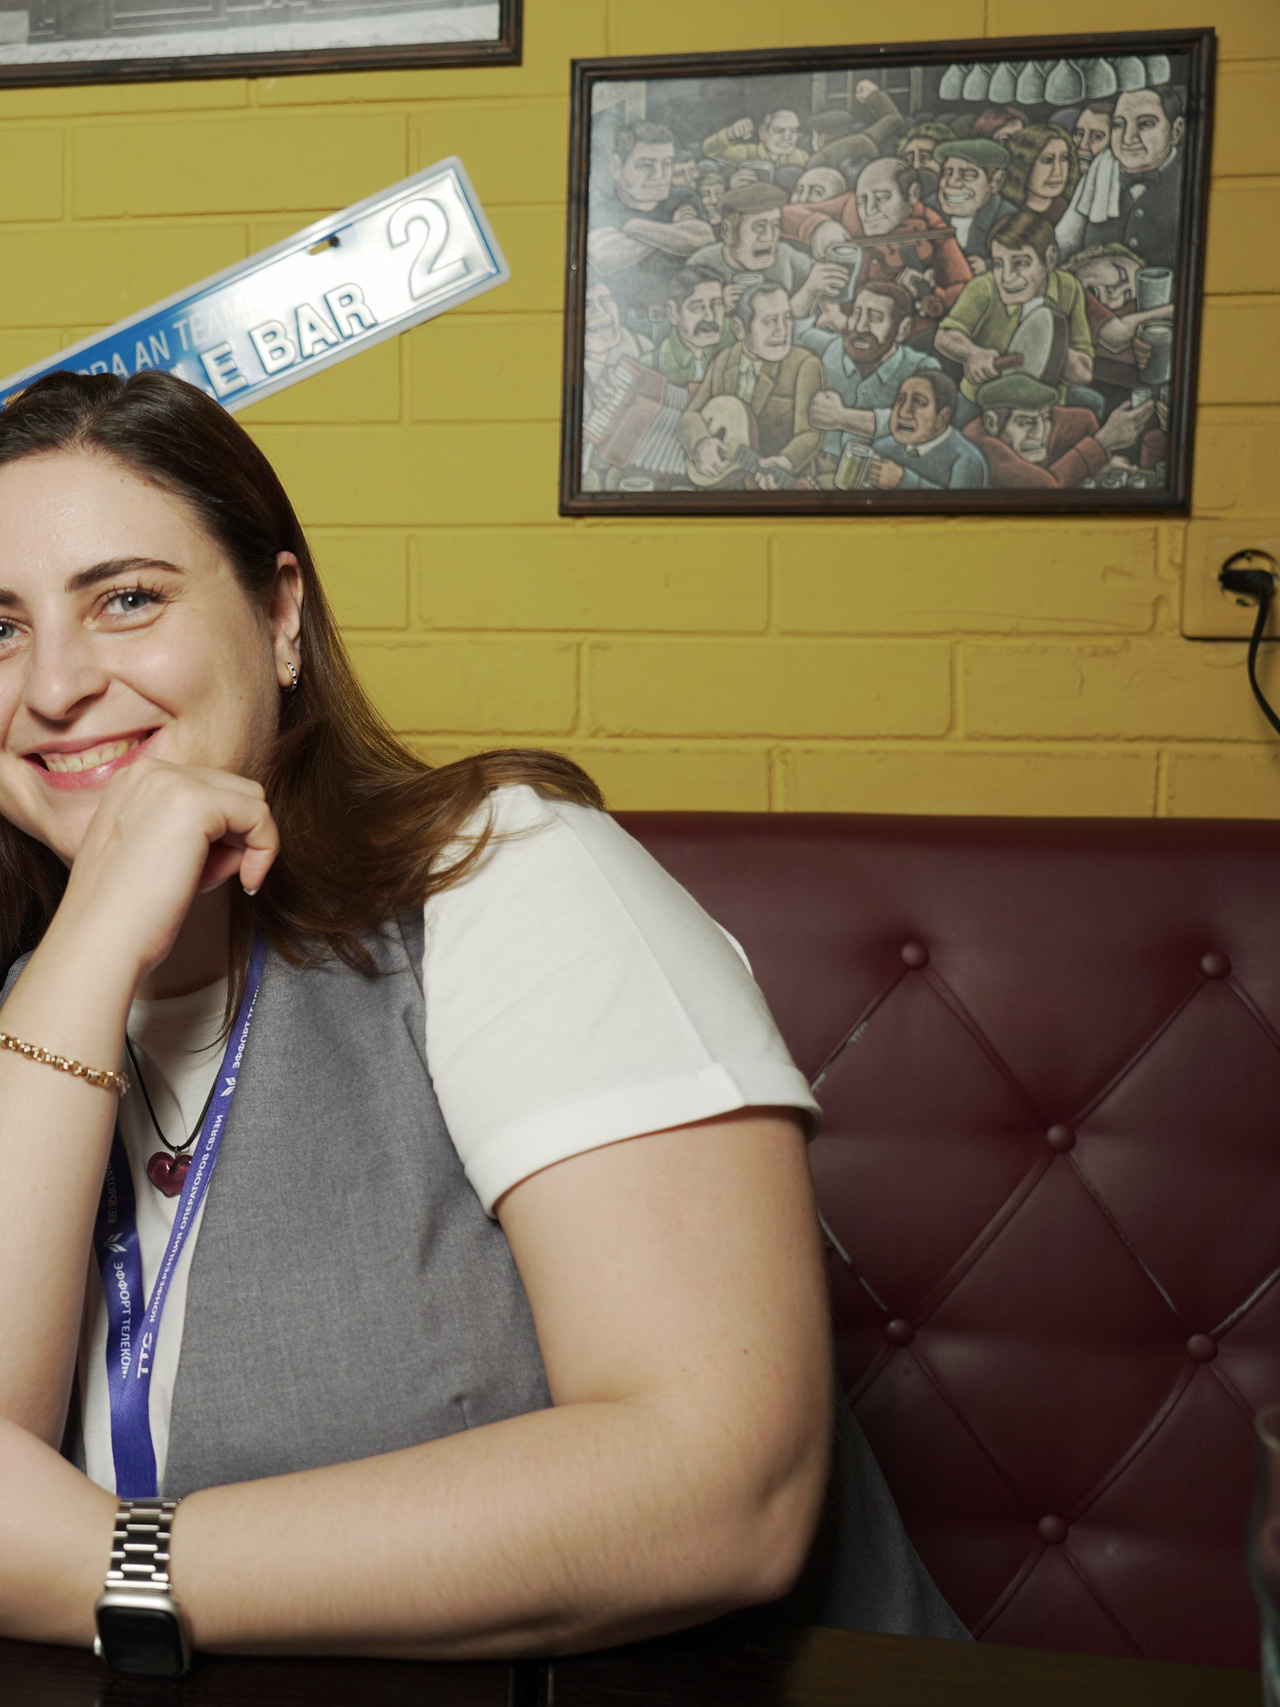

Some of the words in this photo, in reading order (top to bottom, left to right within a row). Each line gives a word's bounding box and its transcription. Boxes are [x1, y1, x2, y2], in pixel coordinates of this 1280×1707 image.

[388, 198, 469, 300] 2
[134, 330, 171, 370] AN
[249, 282, 378, 376] BAR
[149, 1232, 183, 1323] КОНФЕРЕНЦИЯ
[180, 1153, 209, 1230] ОПЕРАТОРОВ
[205, 1114, 224, 1151] СВЯЗИ
[113, 1261, 131, 1315] ЭФФОРТ
